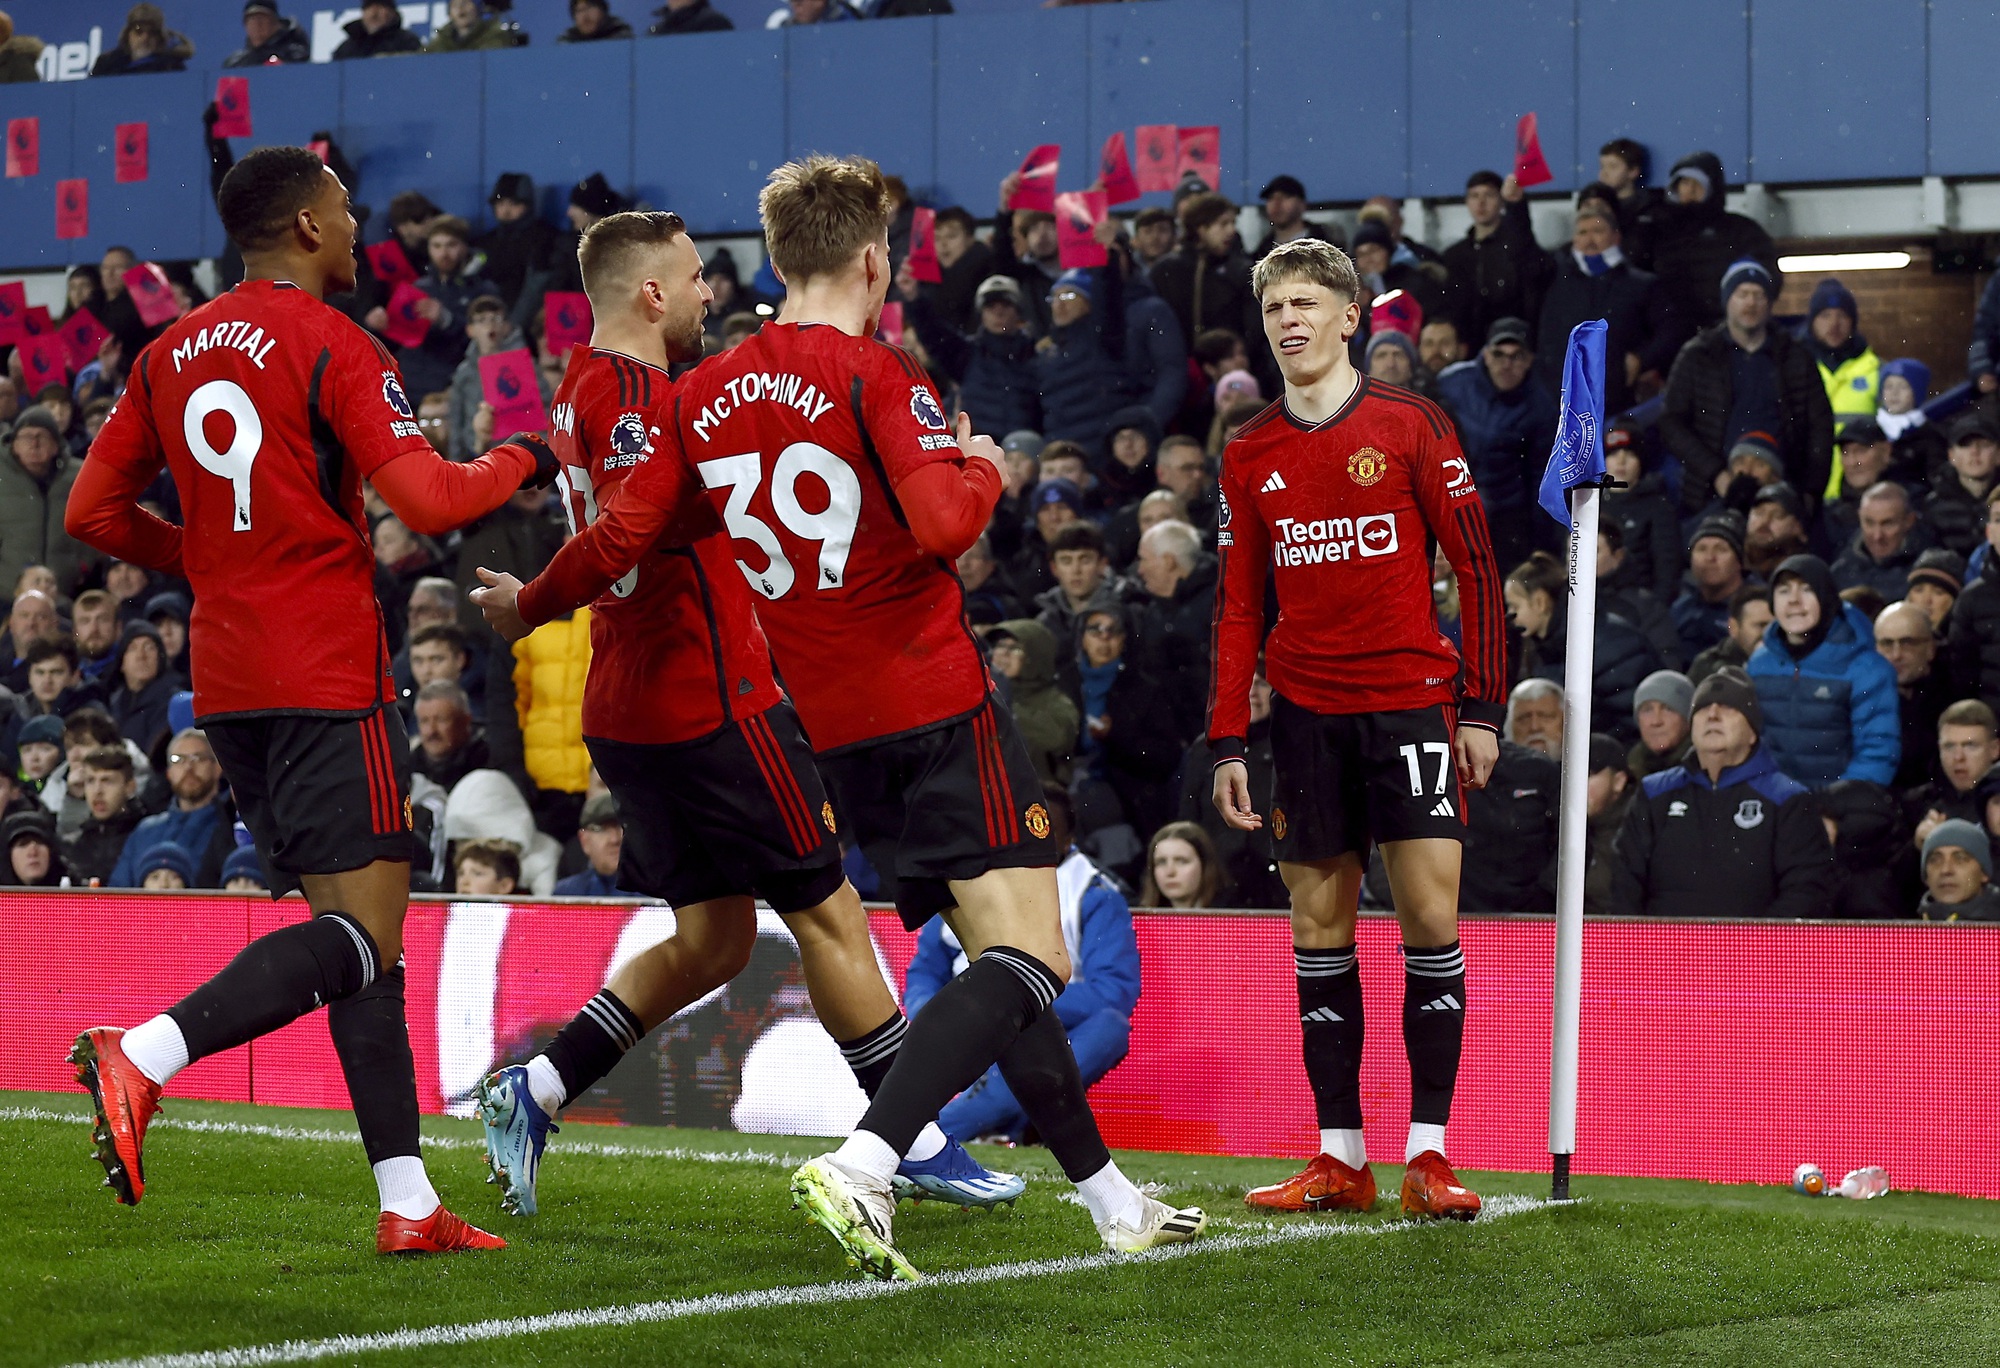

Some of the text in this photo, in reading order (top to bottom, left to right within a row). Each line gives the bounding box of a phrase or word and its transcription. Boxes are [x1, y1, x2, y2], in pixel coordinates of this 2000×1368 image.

[172, 320, 276, 373] MARTIAL
[183, 379, 262, 531] 9
[603, 456, 617, 465] No
[696, 441, 862, 600] 39
[1275, 517, 1354, 544] Team
[1570, 521, 1581, 586] precisionpro
[1400, 742, 1450, 796] 17
